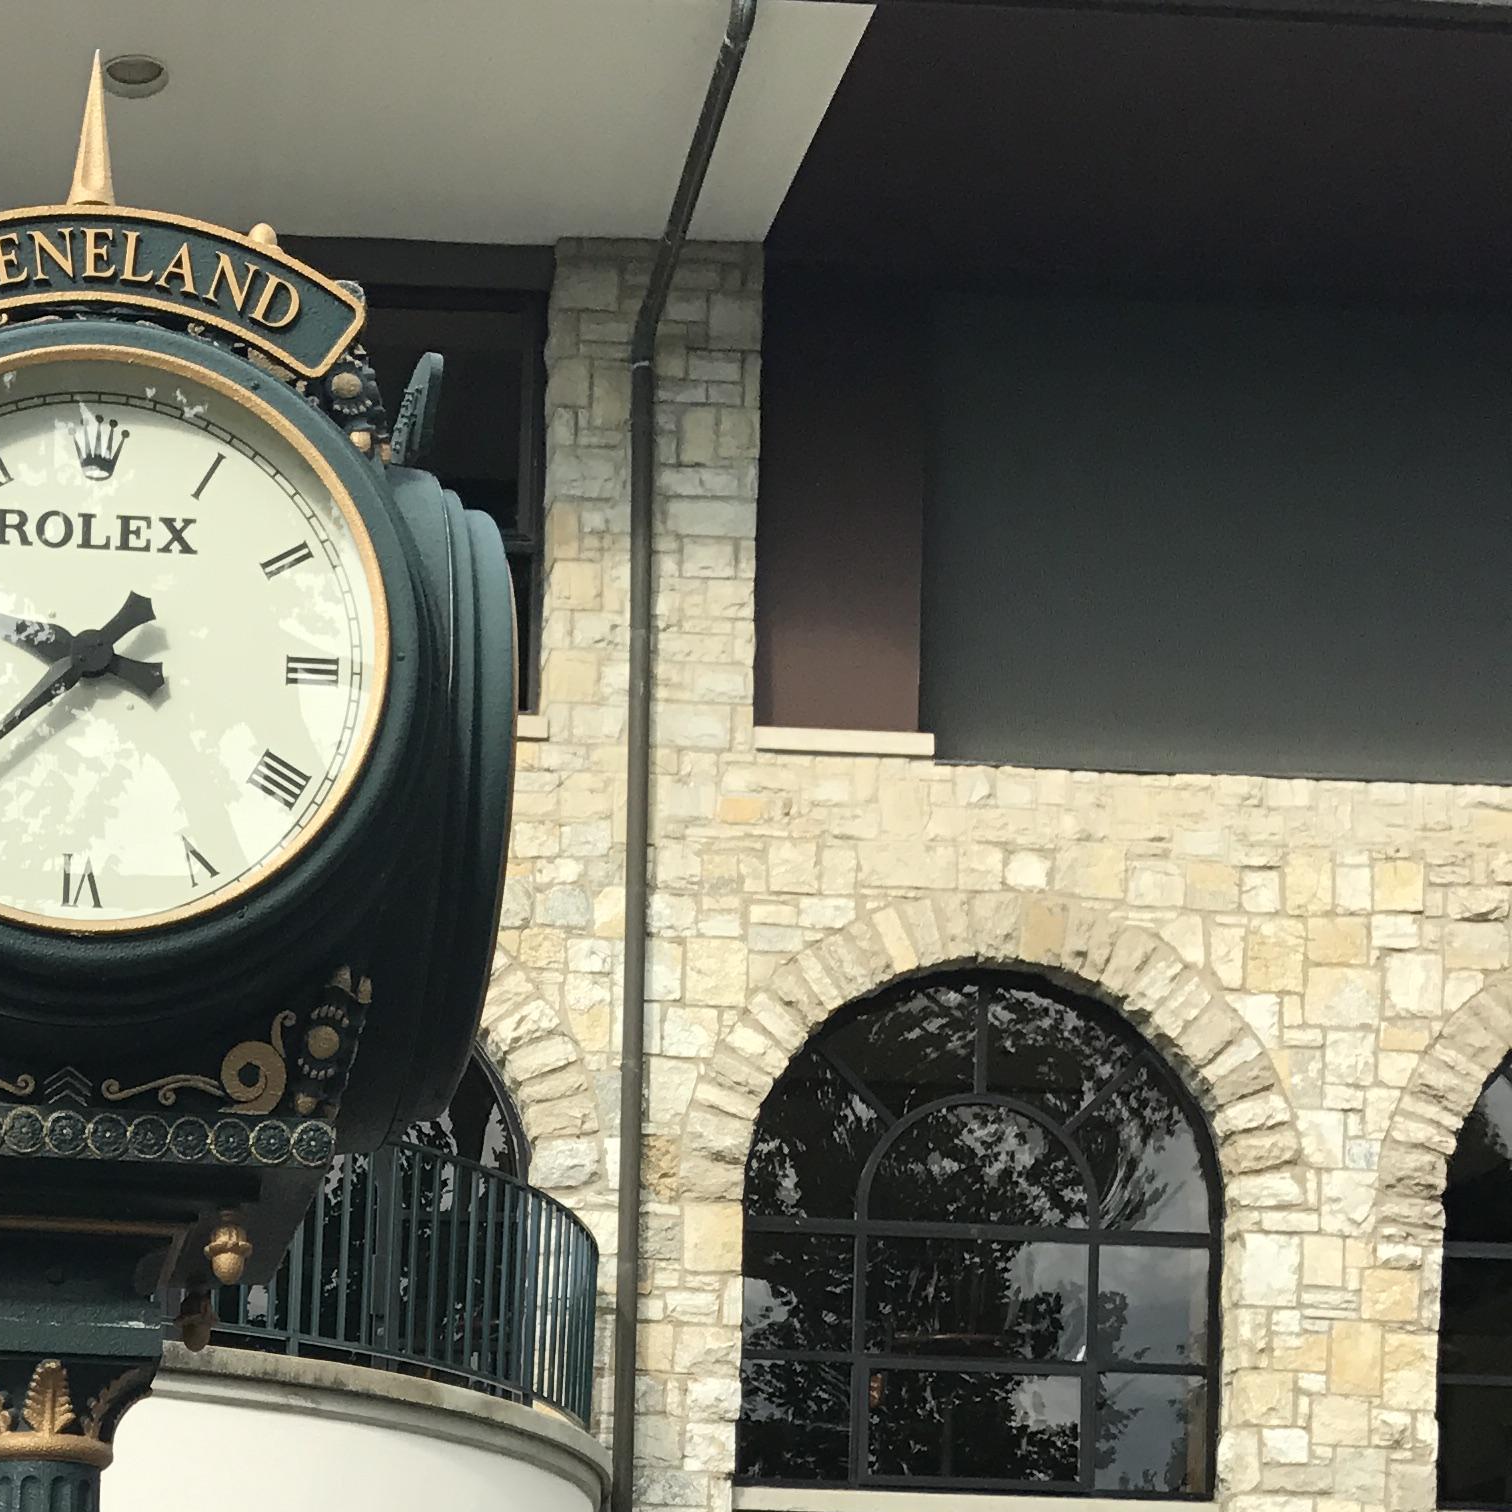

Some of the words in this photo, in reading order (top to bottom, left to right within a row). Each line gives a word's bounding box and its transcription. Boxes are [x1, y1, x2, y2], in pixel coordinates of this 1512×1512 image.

[191, 452, 226, 500] I
[259, 541, 314, 580] II
[286, 655, 339, 687] III
[246, 749, 312, 811] IIII
[61, 853, 103, 908] VI
[182, 834, 220, 887] V
